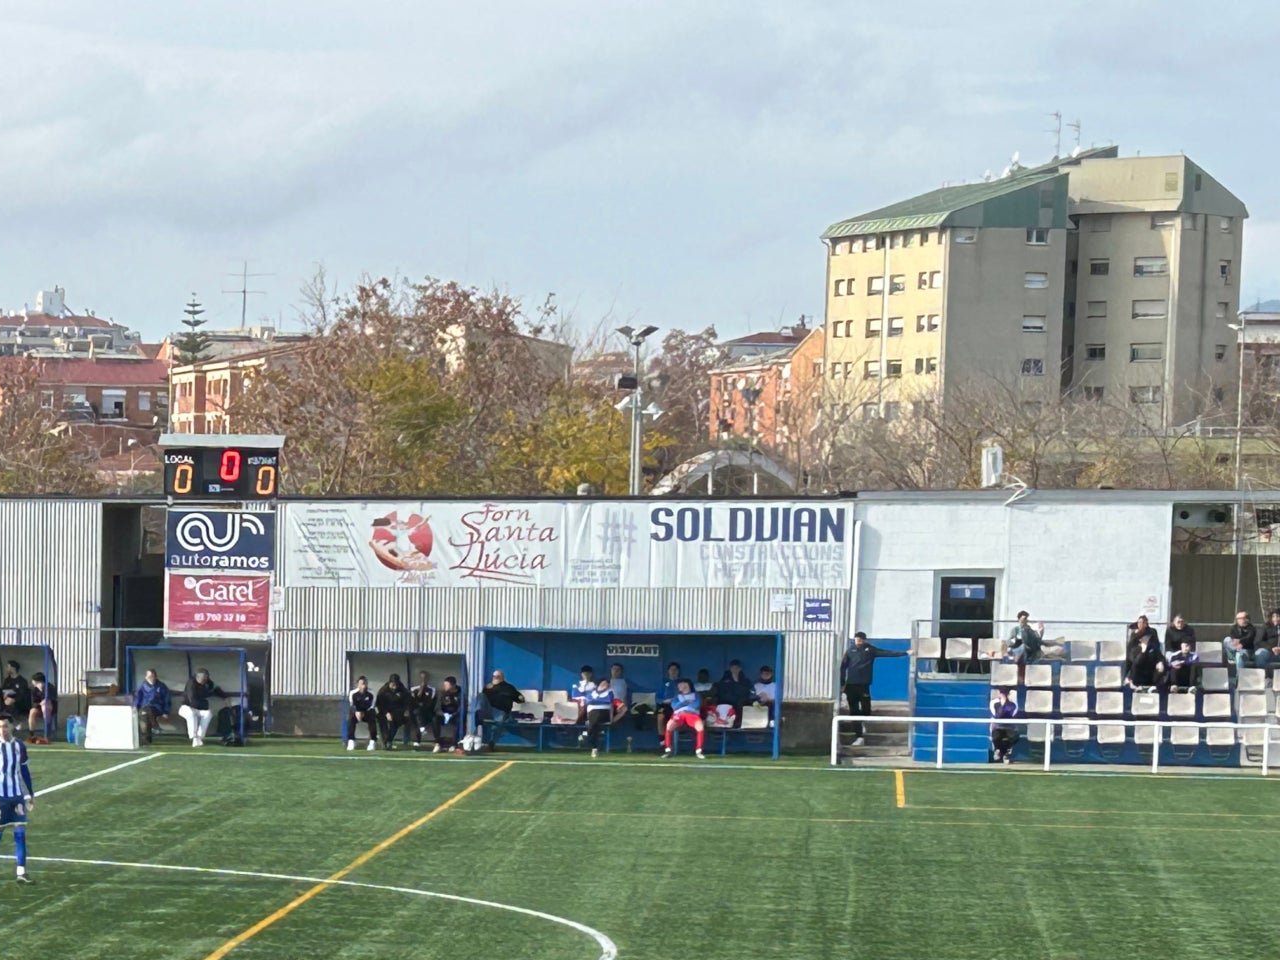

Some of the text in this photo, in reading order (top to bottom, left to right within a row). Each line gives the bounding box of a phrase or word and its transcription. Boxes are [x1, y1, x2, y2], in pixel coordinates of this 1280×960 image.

[164, 454, 195, 465] LOCAL
[220, 450, 241, 481] 0
[174, 464, 193, 494] 0
[256, 466, 275, 495] 0
[448, 510, 559, 547] Santa
[170, 554, 270, 569] autoramos
[194, 578, 254, 602] Gatel
